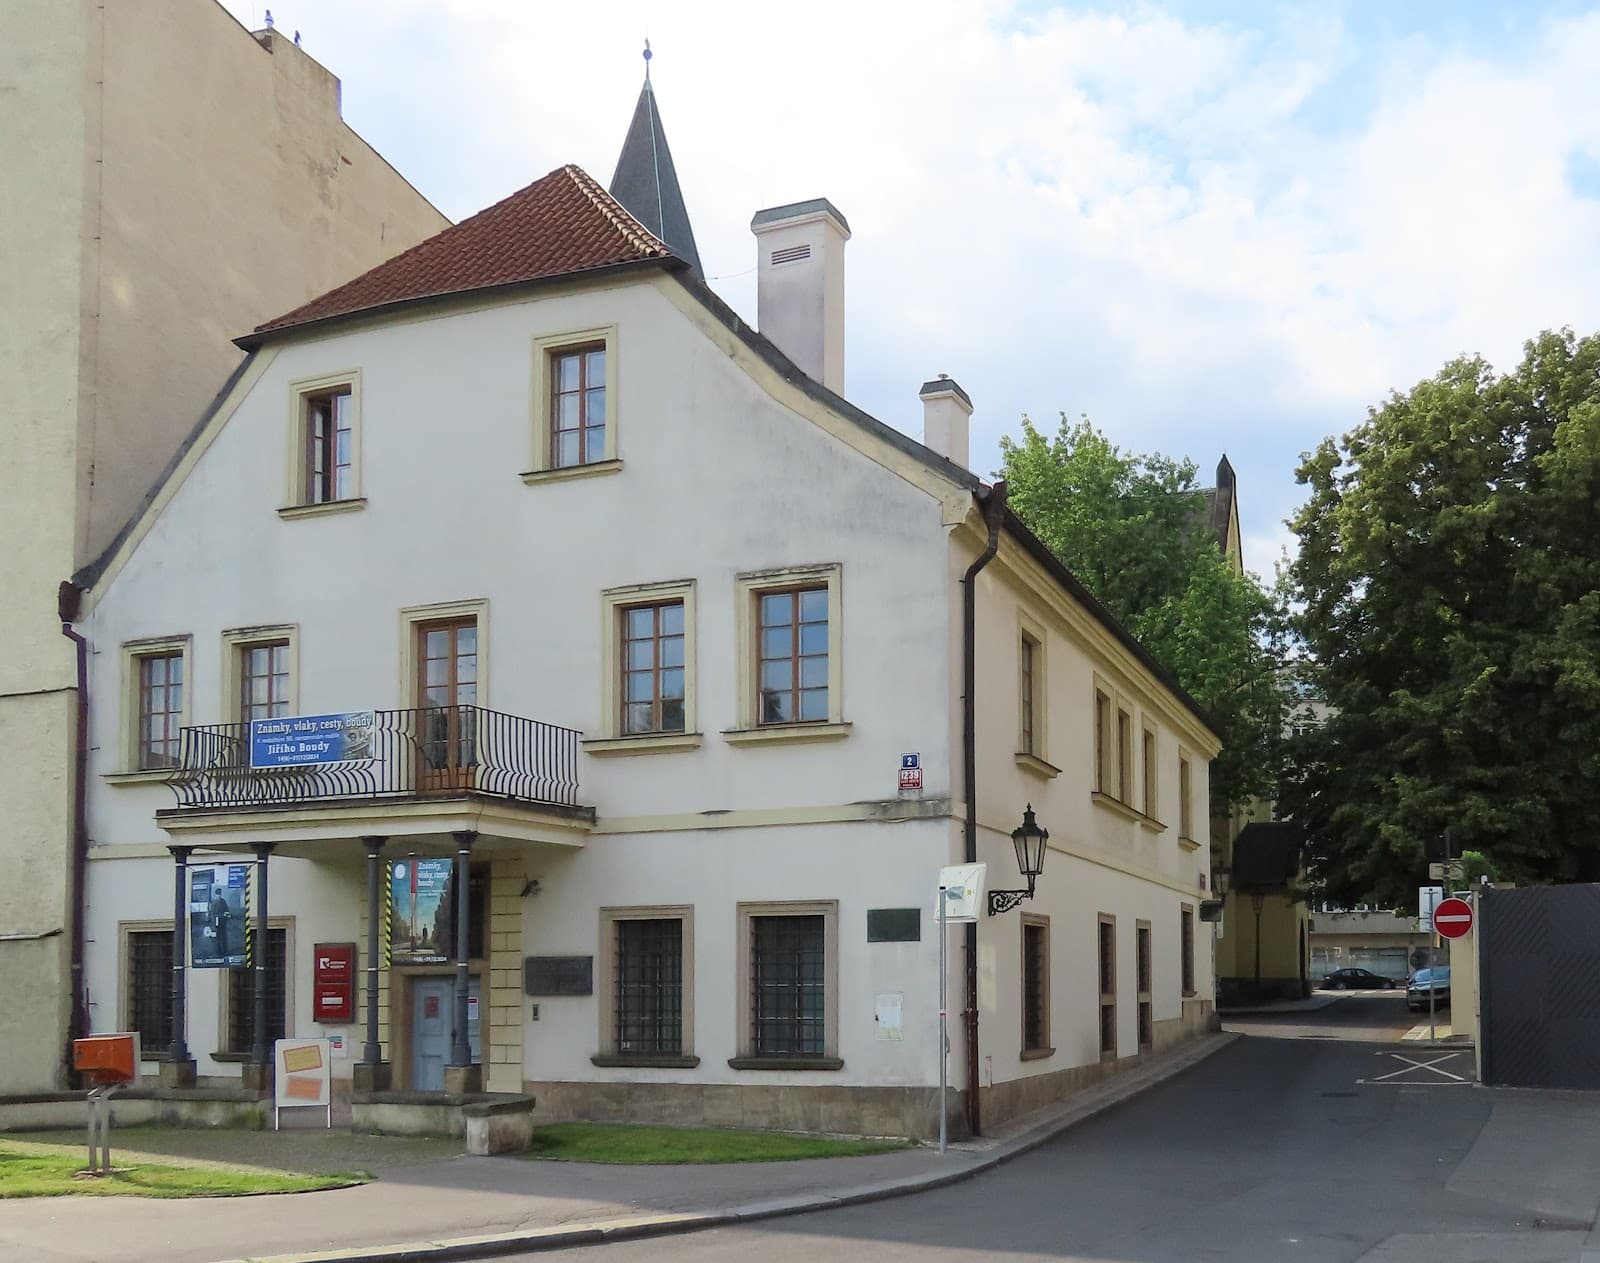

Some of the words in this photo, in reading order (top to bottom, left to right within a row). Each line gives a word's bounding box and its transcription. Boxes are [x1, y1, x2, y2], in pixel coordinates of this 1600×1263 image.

[257, 722, 292, 735] Známky,
[294, 720, 319, 732] vlaky,
[320, 719, 344, 730] cesty,
[346, 717, 372, 729] boudy
[268, 743, 296, 754] Jiřího
[299, 742, 330, 752] Boudy
[907, 757, 913, 766] 2
[901, 771, 919, 780] 1239
